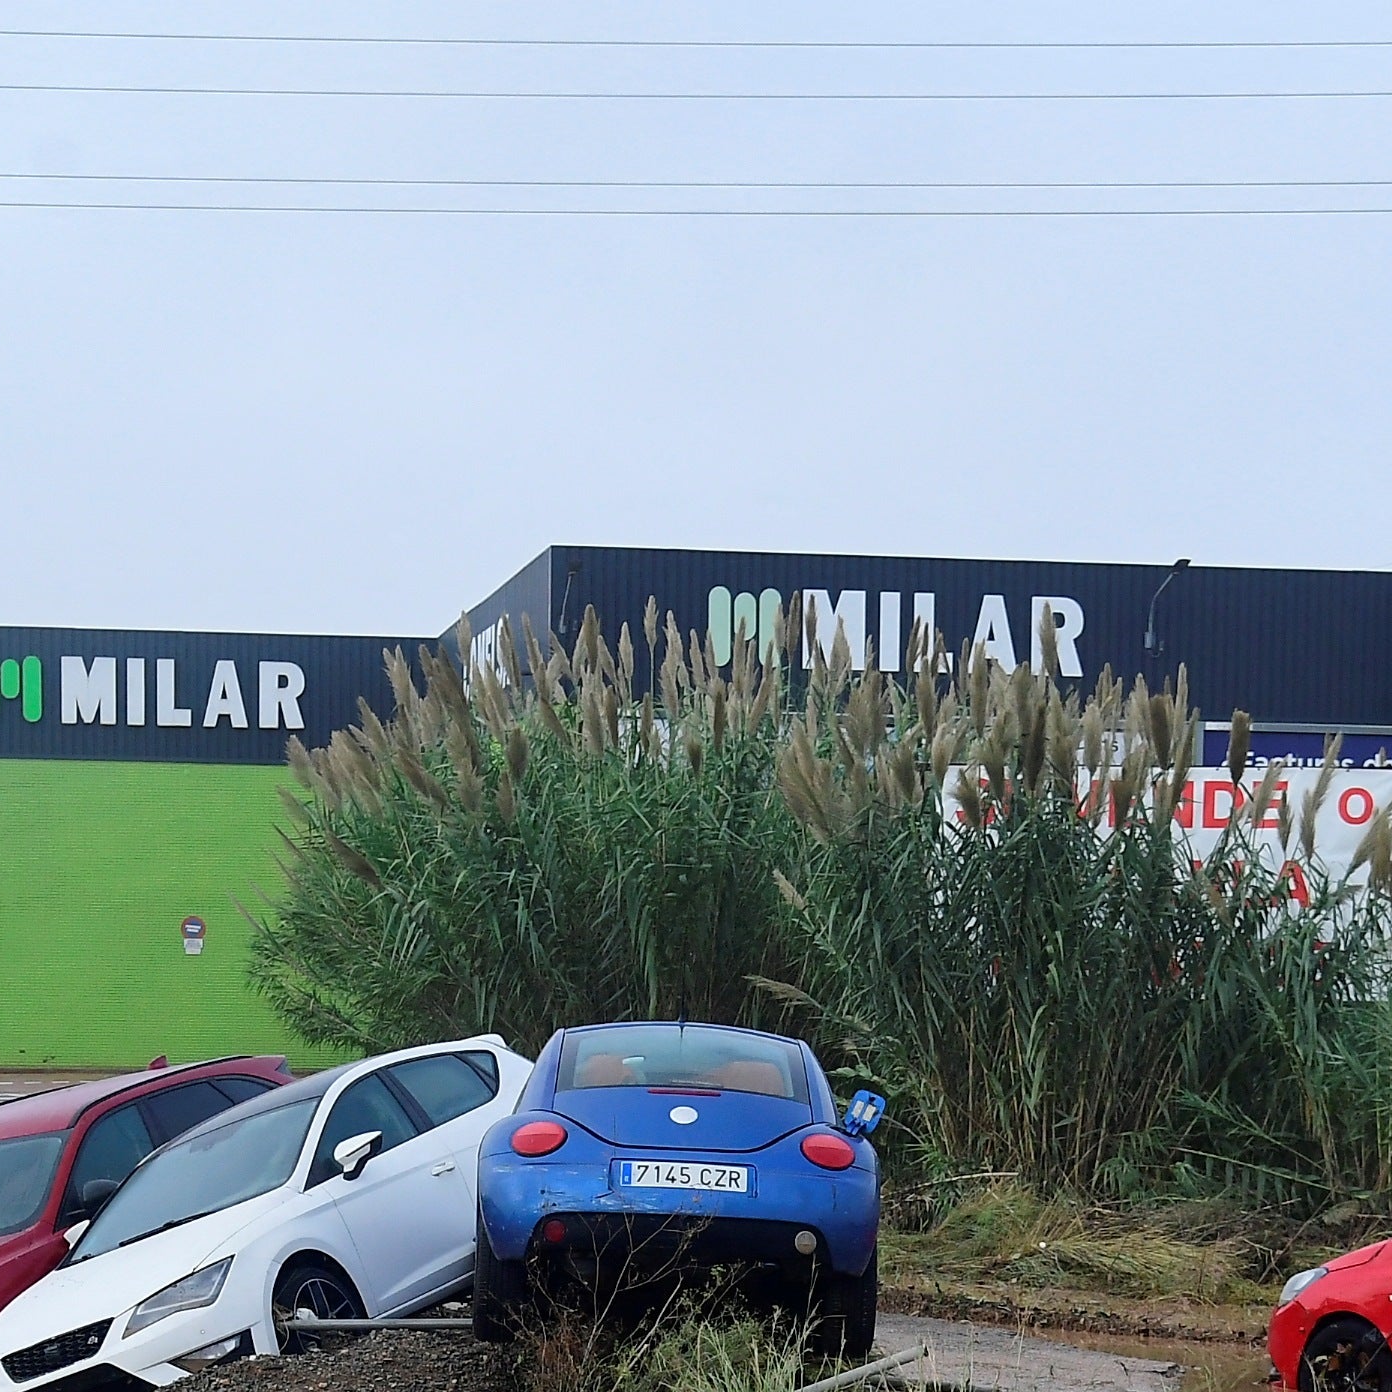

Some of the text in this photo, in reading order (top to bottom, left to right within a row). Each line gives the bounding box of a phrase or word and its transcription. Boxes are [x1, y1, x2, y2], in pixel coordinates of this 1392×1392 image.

[802, 589, 1084, 677] MILAR
[60, 655, 306, 730] MILAR
[1338, 787, 1374, 825] O
[637, 1165, 741, 1189] 7145 CZR
